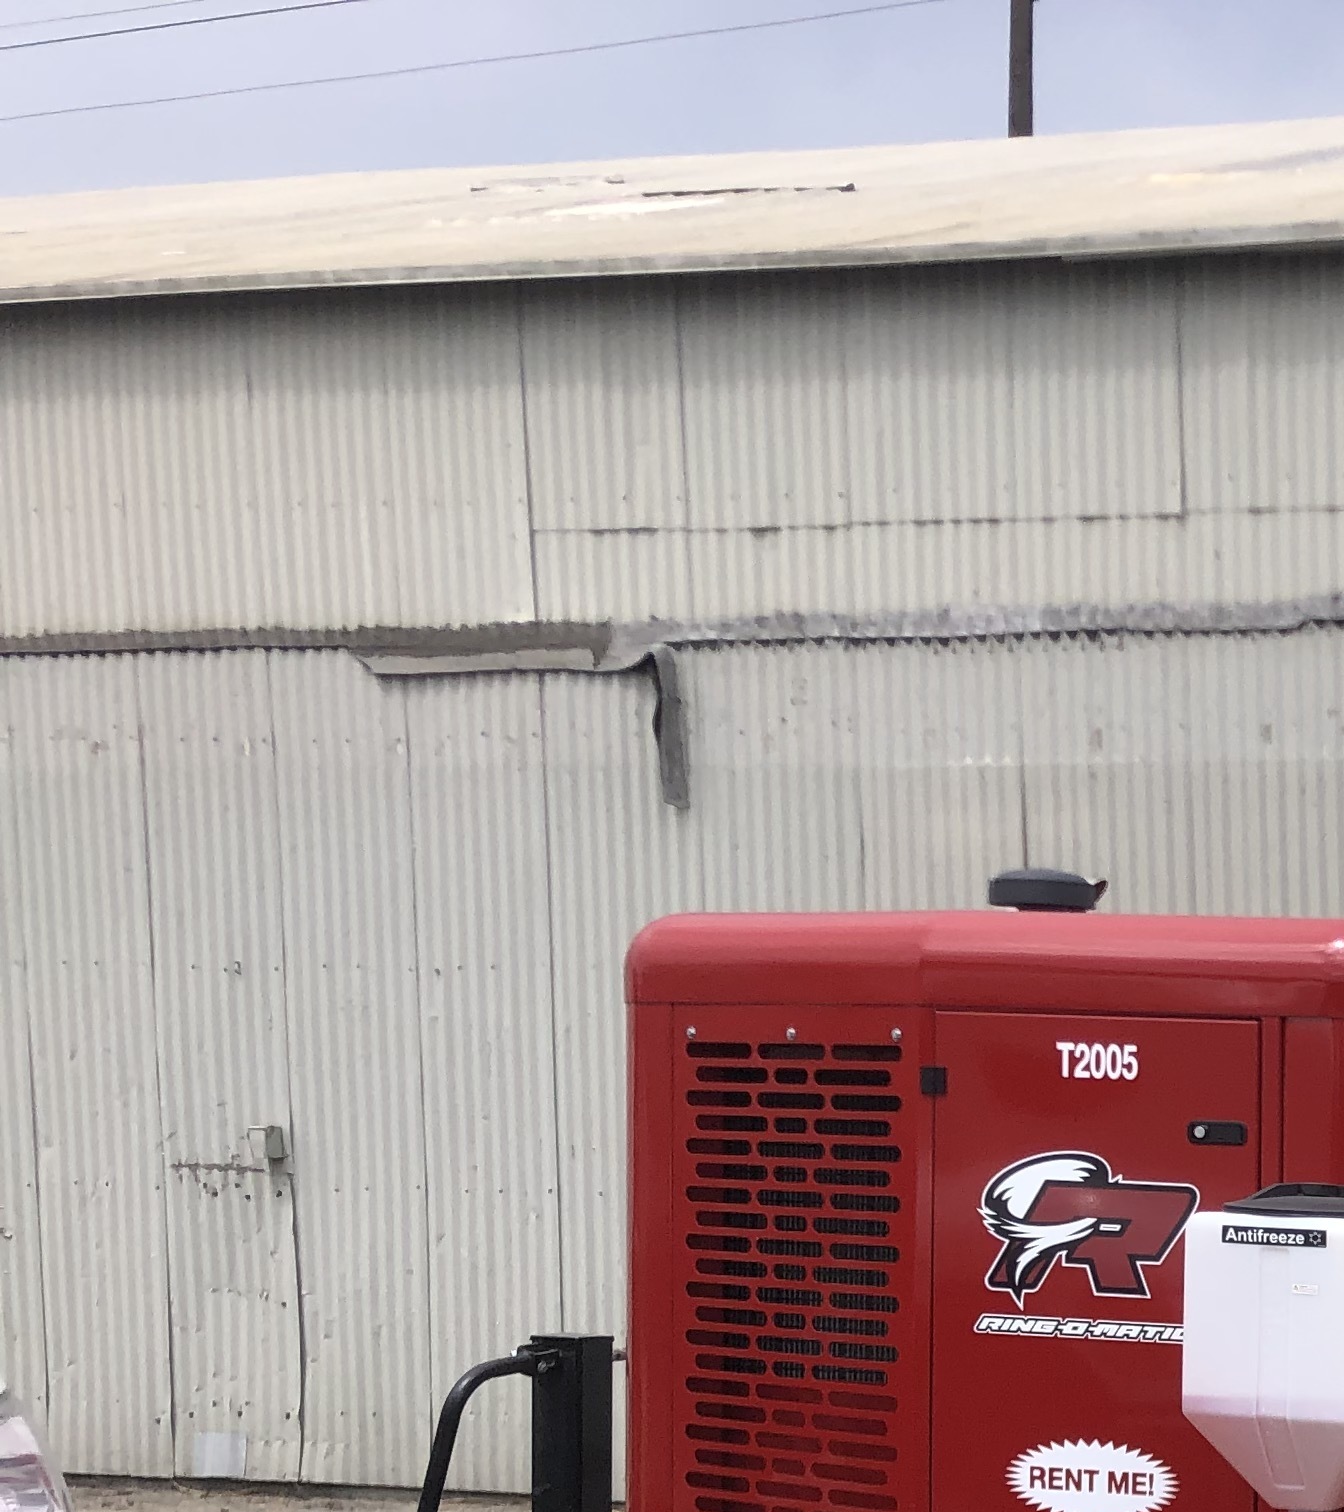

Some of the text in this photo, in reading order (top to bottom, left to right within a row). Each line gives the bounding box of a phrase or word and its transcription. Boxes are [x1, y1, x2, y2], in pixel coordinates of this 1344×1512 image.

[1056, 1041, 1139, 1080] T2005
[1225, 1227, 1305, 1245] Antifreeze
[1029, 1466, 1154, 1496] RENT ME!
